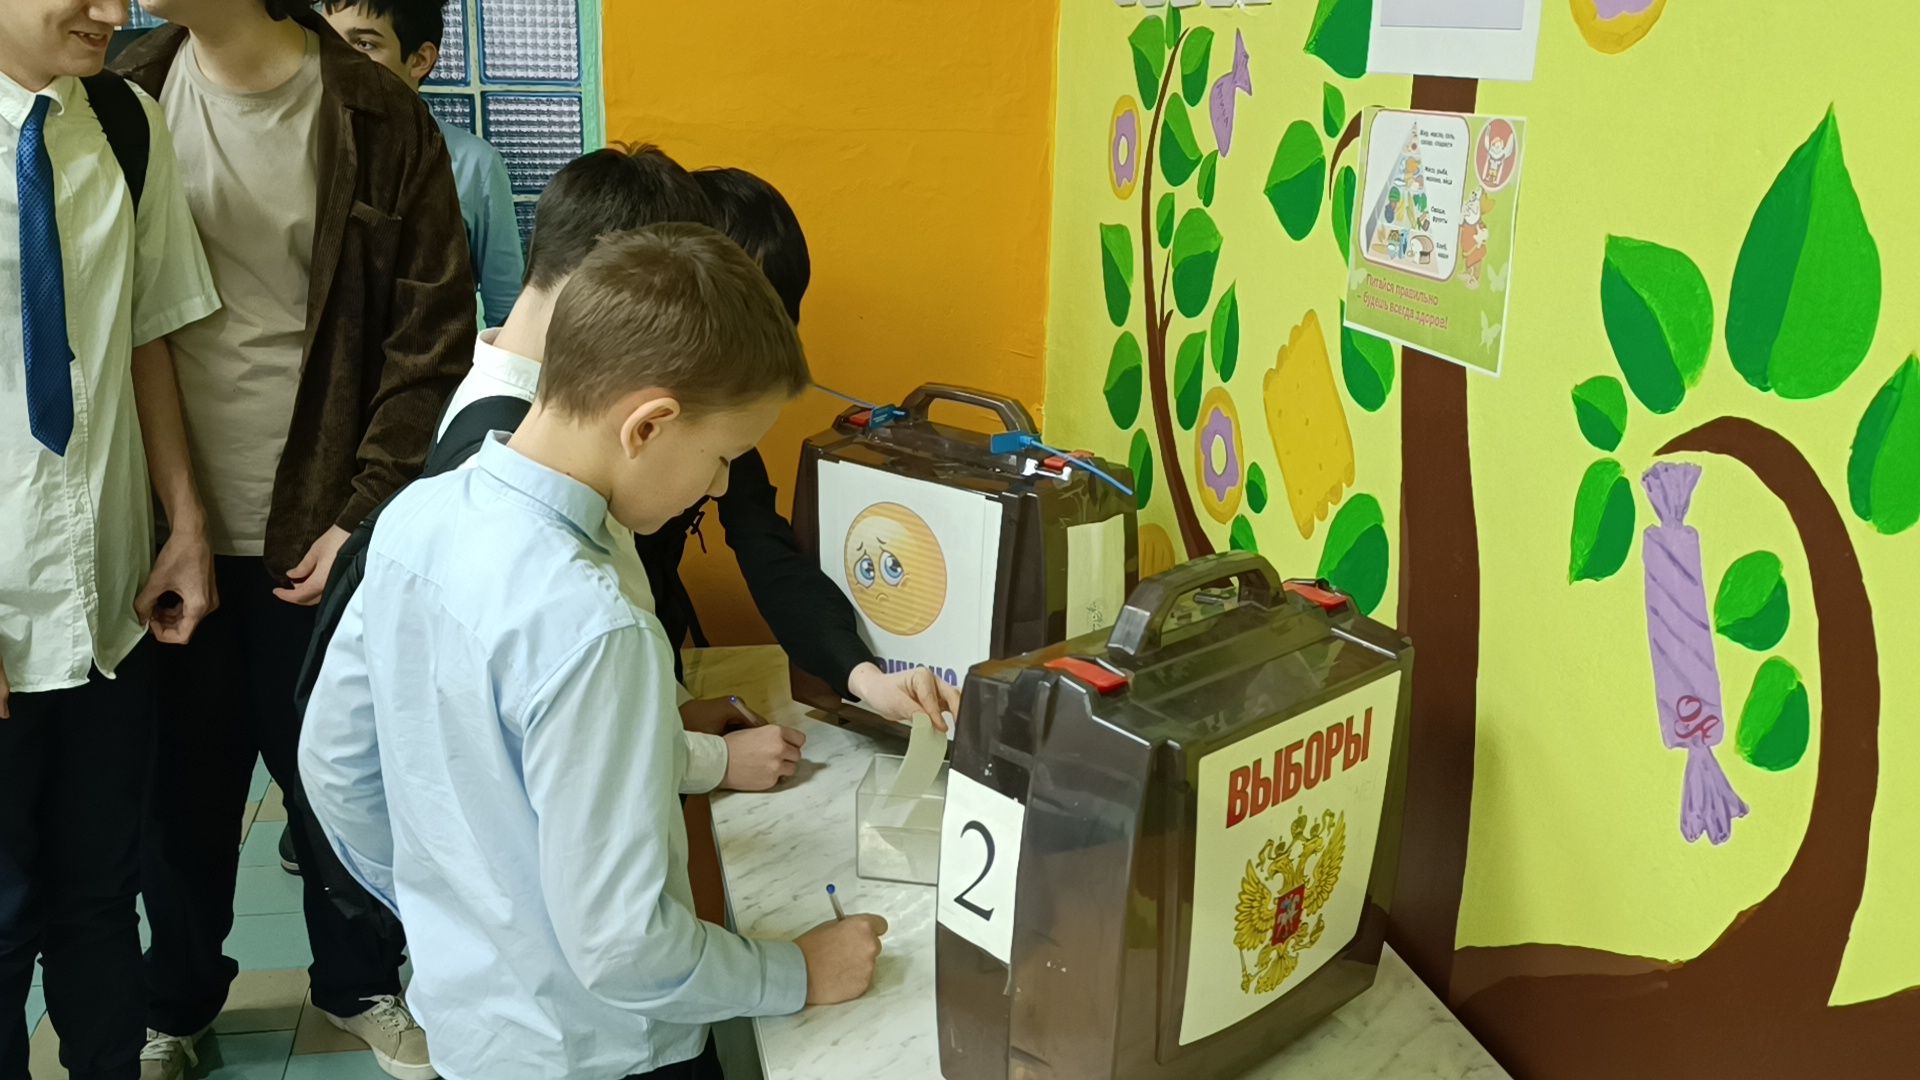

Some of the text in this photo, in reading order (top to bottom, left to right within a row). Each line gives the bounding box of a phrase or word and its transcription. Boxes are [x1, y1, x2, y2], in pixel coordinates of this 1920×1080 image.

[1363, 291, 1388, 312] будешь
[1390, 302, 1414, 320] всегда
[1416, 311, 1448, 330] здоров!
[1367, 273, 1439, 306] Питайся правильно
[1226, 706, 1373, 829] ВЫБОРЫ
[953, 819, 996, 922] 2
